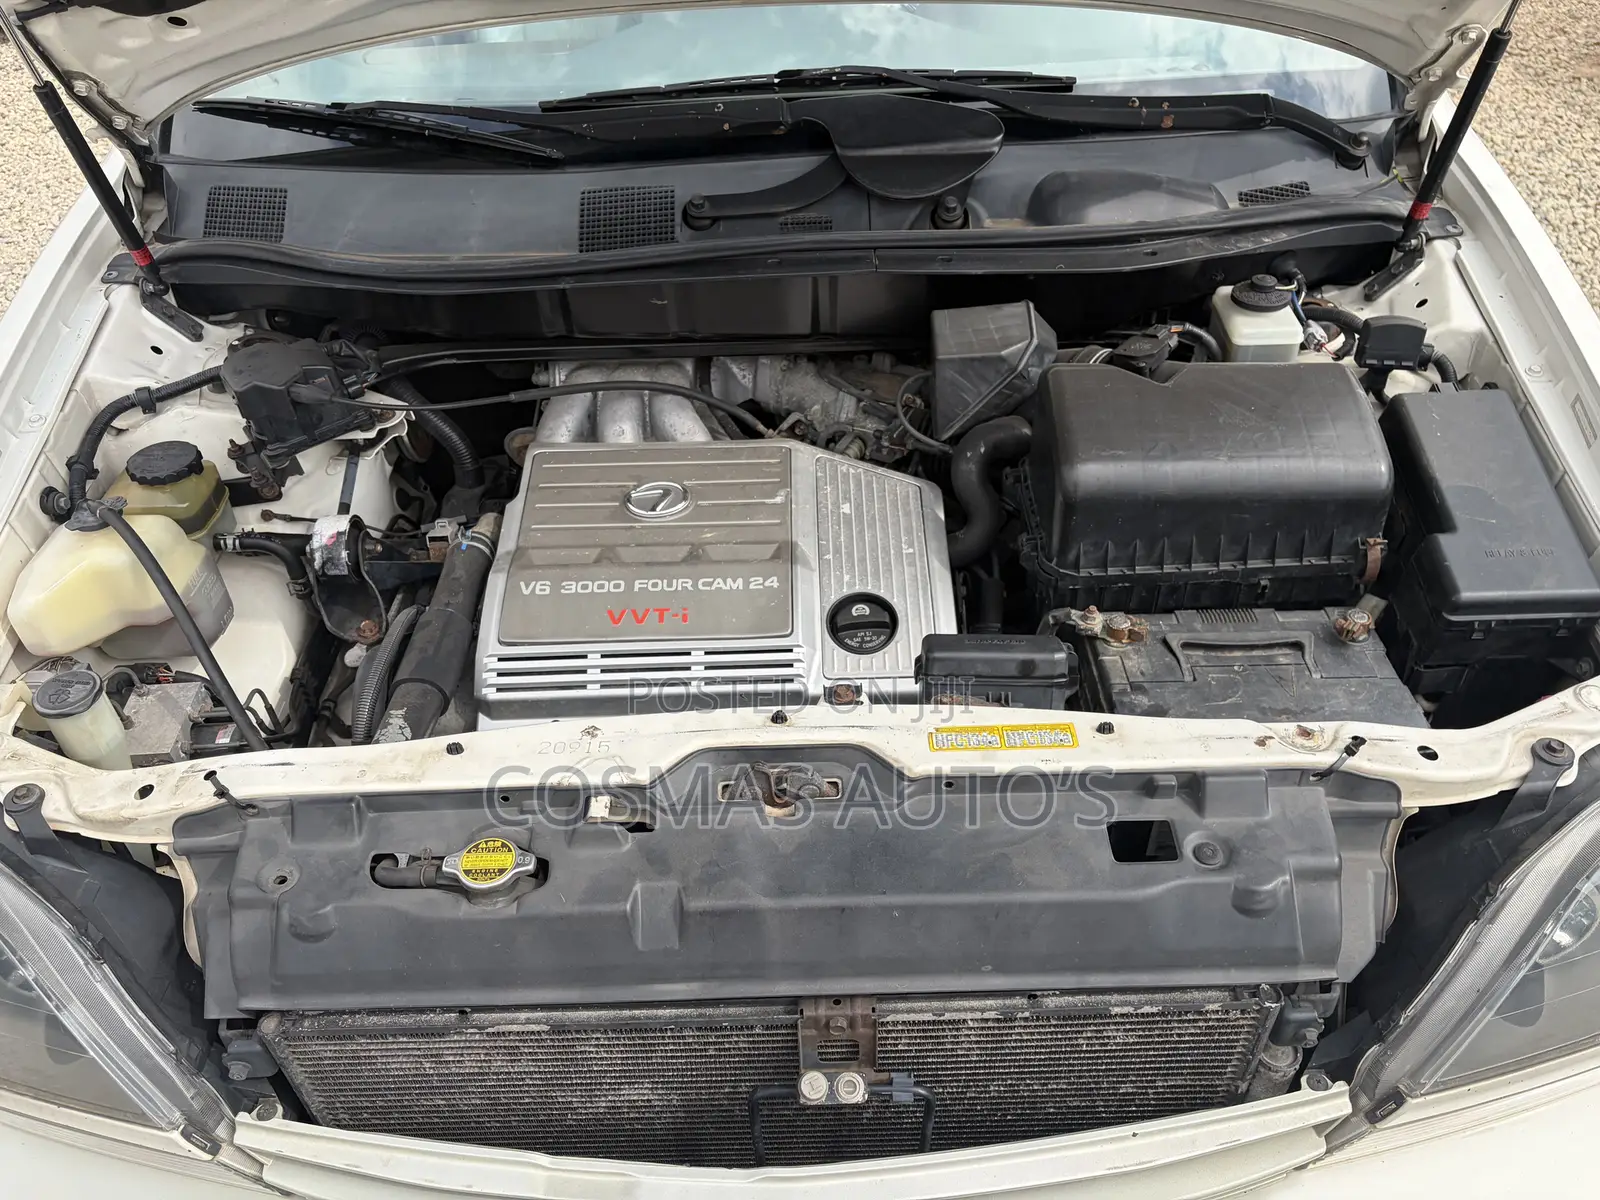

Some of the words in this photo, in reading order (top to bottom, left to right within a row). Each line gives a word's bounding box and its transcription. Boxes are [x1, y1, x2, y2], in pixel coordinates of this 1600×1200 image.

[519, 580, 552, 596] V6
[560, 579, 626, 595] 3000
[633, 577, 694, 593] FOUR
[698, 576, 744, 592] CAM
[748, 575, 780, 590] 24
[606, 607, 689, 627] VVT-i
[537, 740, 612, 755] 20915
[518, 856, 530, 864] 0.9
